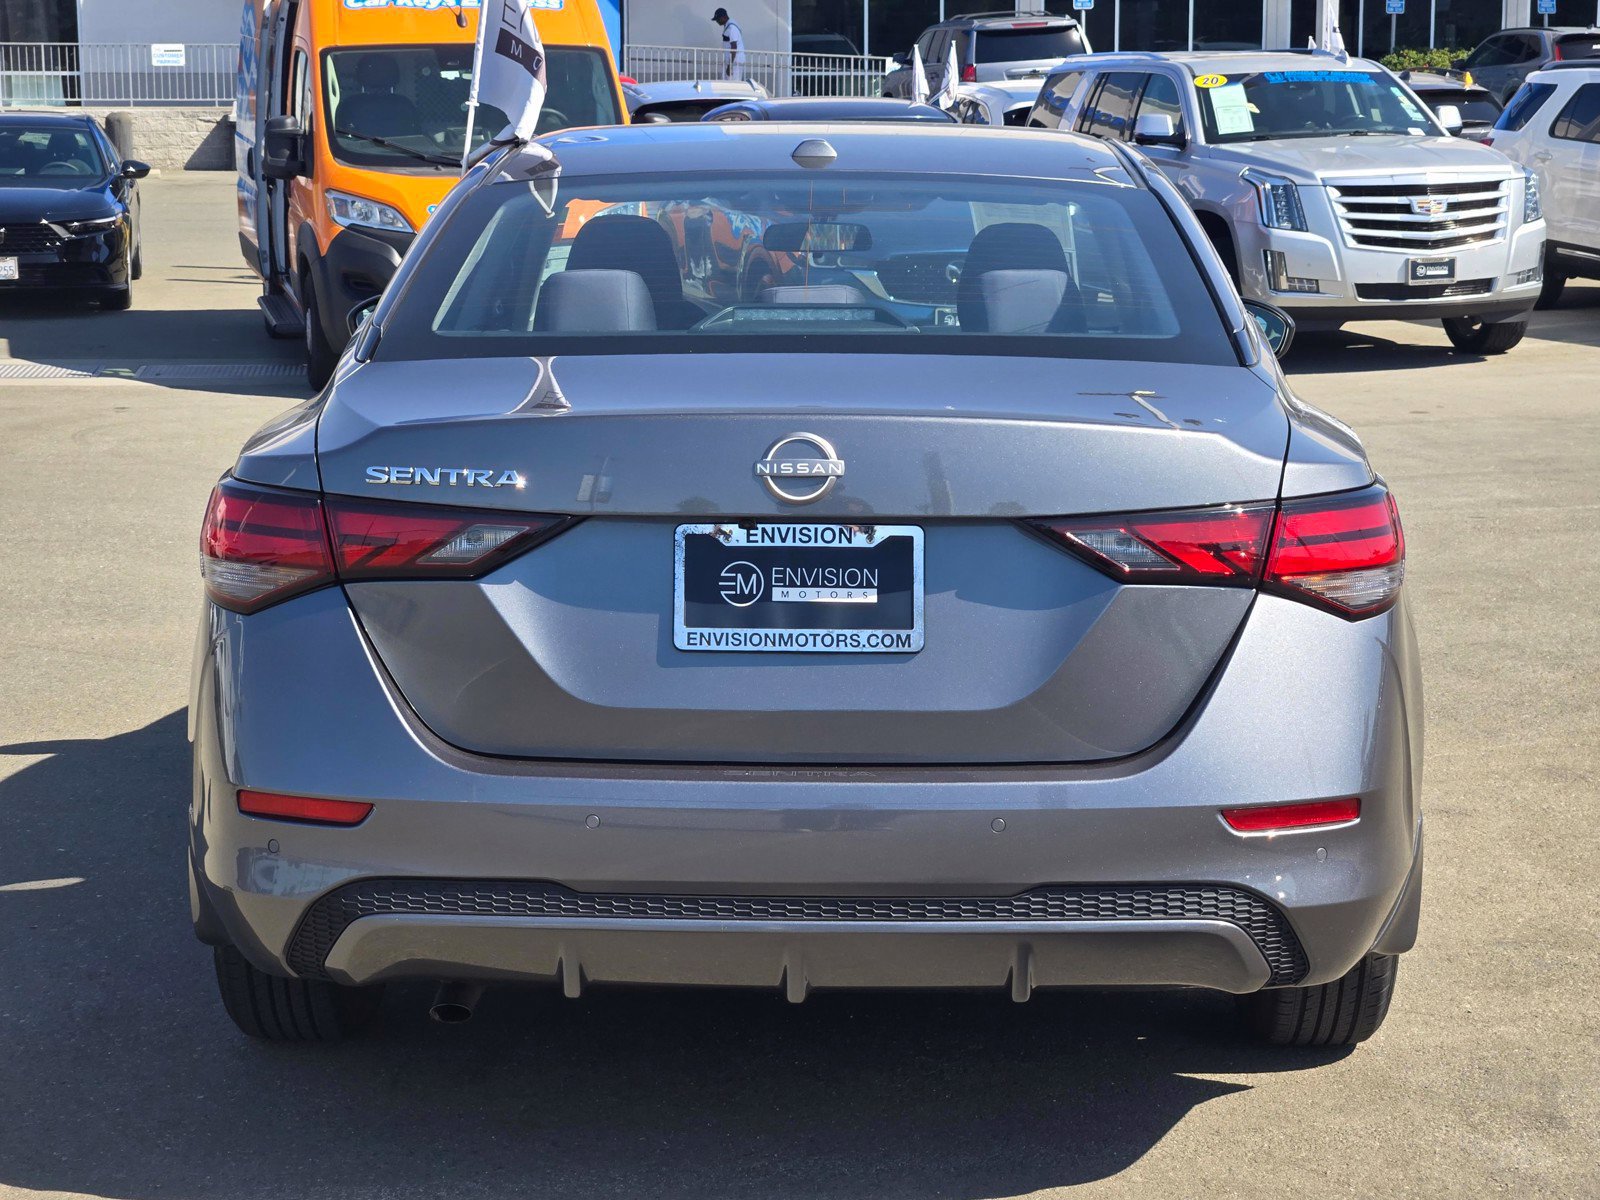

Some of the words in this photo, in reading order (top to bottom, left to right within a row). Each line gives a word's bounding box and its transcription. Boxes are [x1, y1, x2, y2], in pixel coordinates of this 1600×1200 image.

[365, 466, 525, 488] SENTRA
[757, 463, 843, 475] NISSAN
[746, 526, 853, 545] ENVISION
[772, 567, 878, 587] ENVISION
[781, 590, 869, 599] MOTORS
[687, 632, 912, 648] ENVISIONMOTORS.COM
